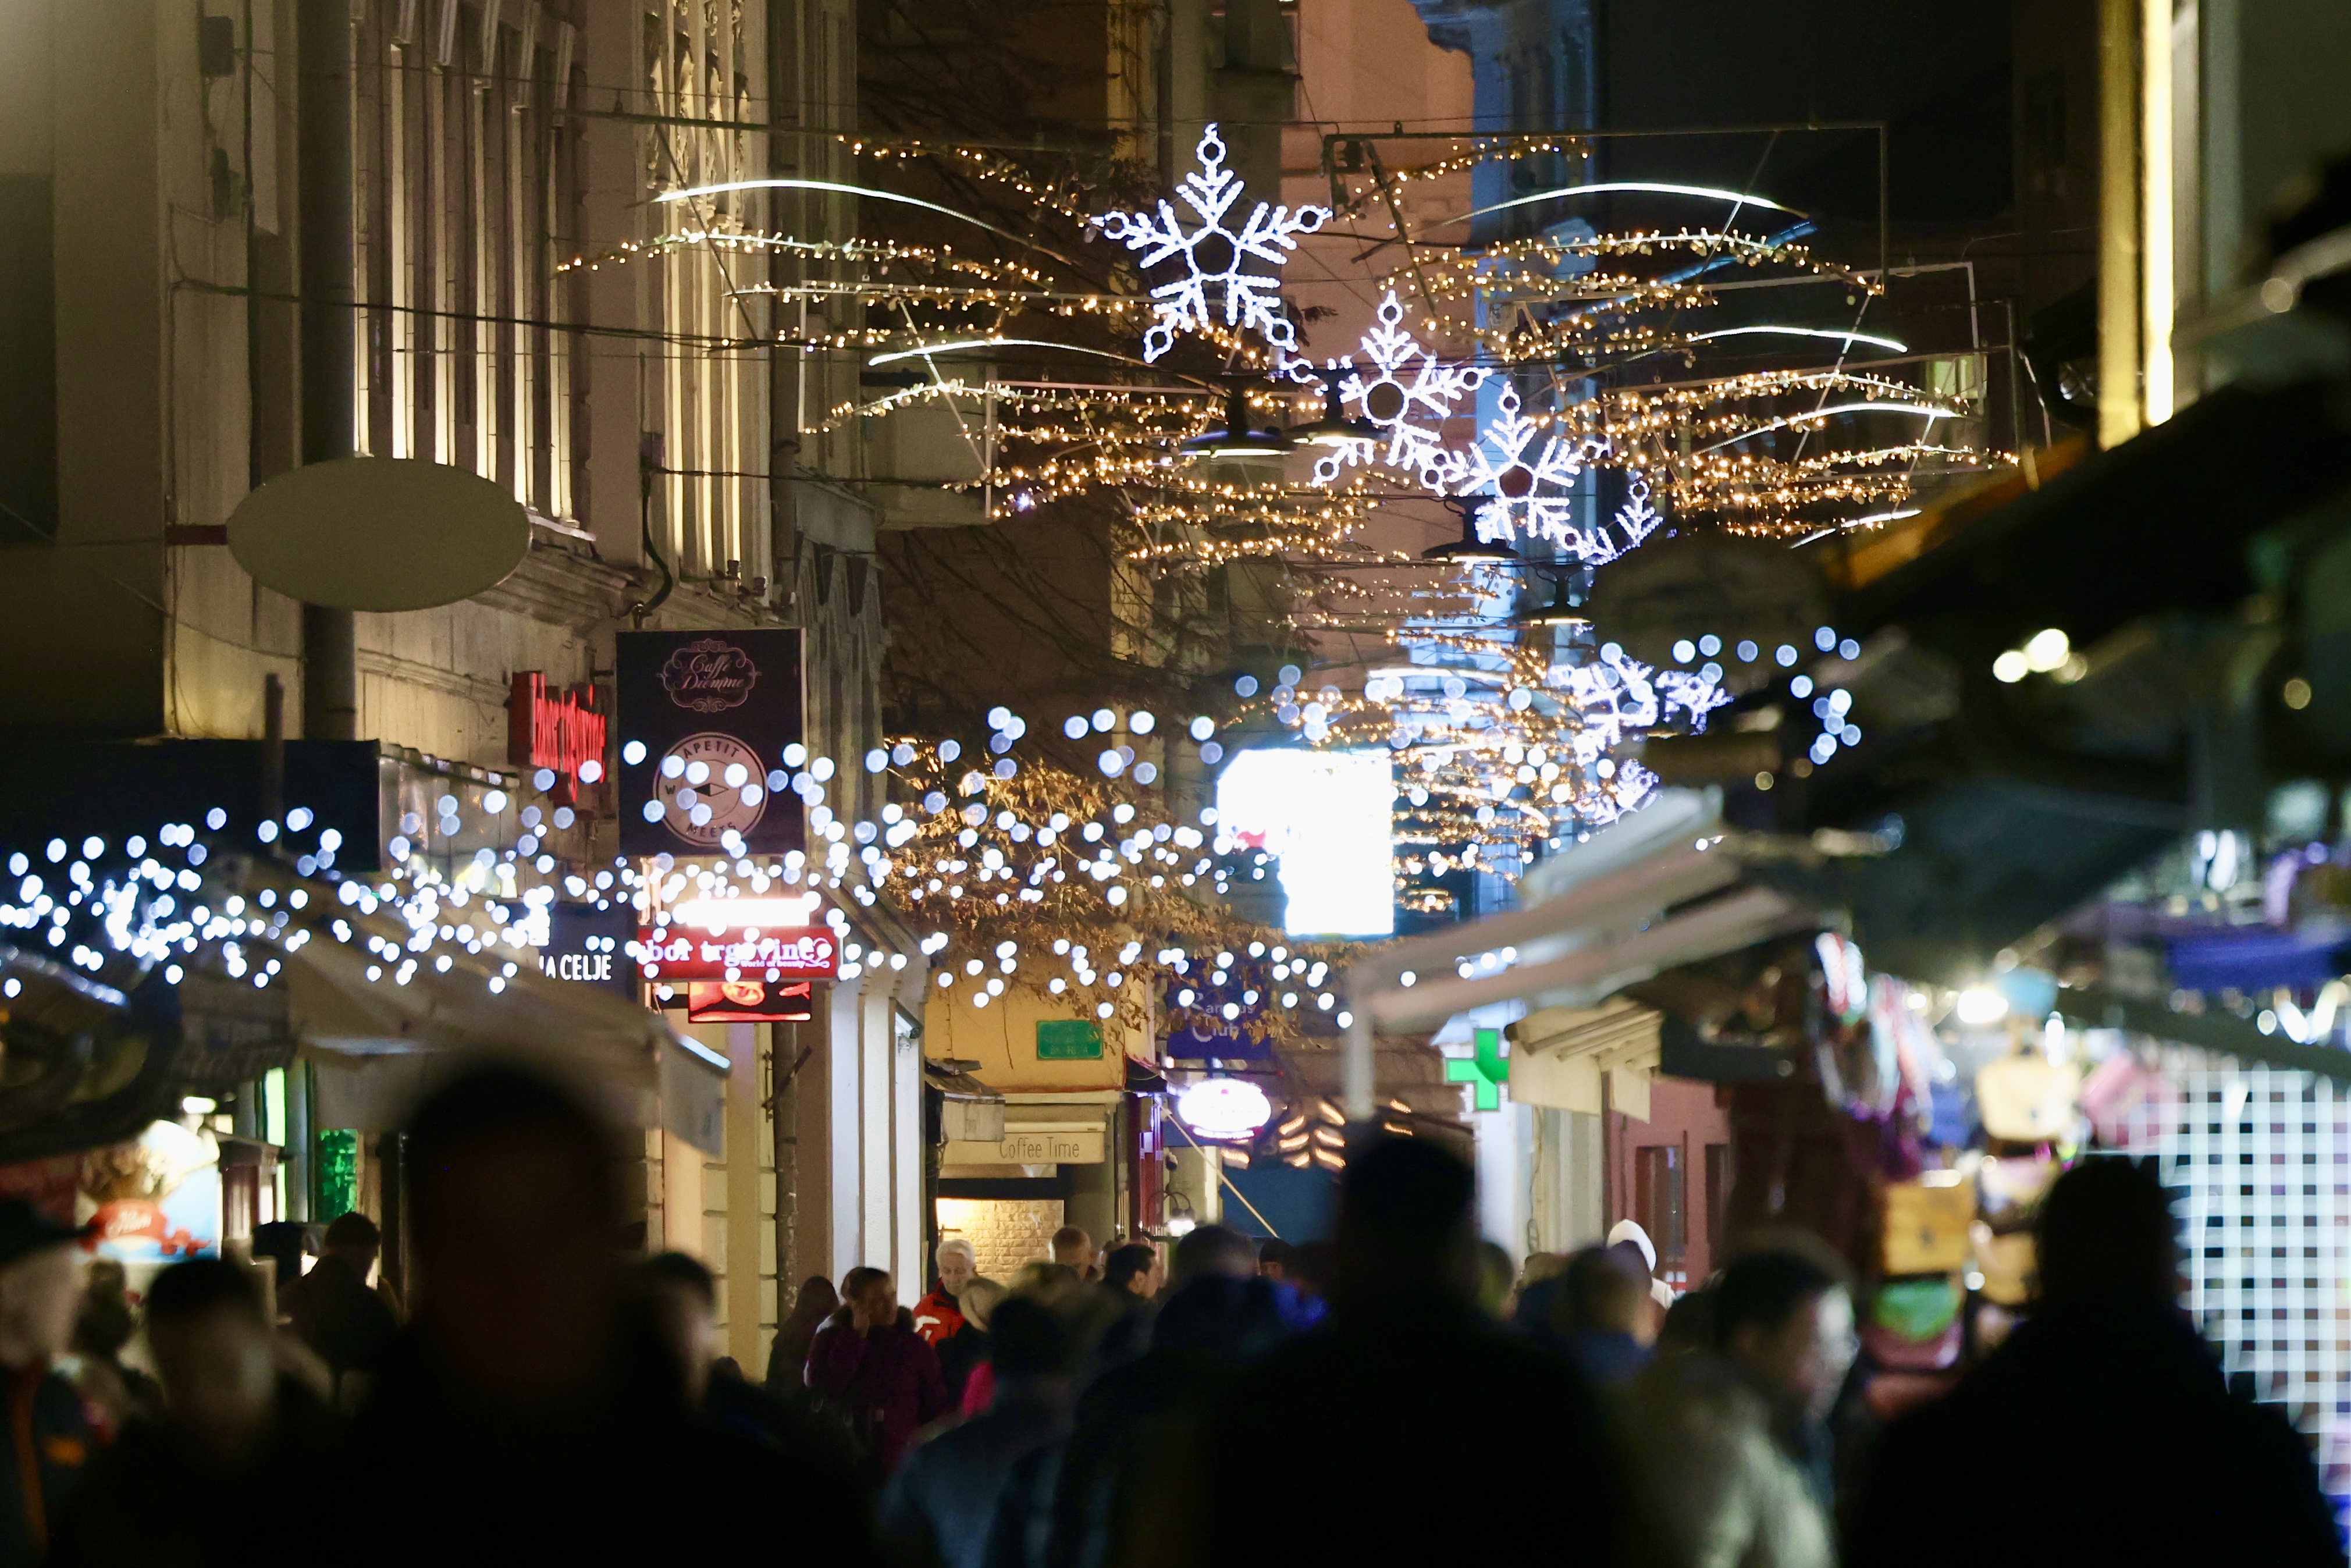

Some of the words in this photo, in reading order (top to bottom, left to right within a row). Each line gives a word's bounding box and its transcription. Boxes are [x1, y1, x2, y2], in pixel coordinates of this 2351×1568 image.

[683, 741, 739, 759] APETIT
[560, 954, 611, 980] CELJE
[777, 960, 806, 969] beauty
[1000, 1137, 1041, 1158] Coffee
[1047, 1136, 1080, 1158] Time
